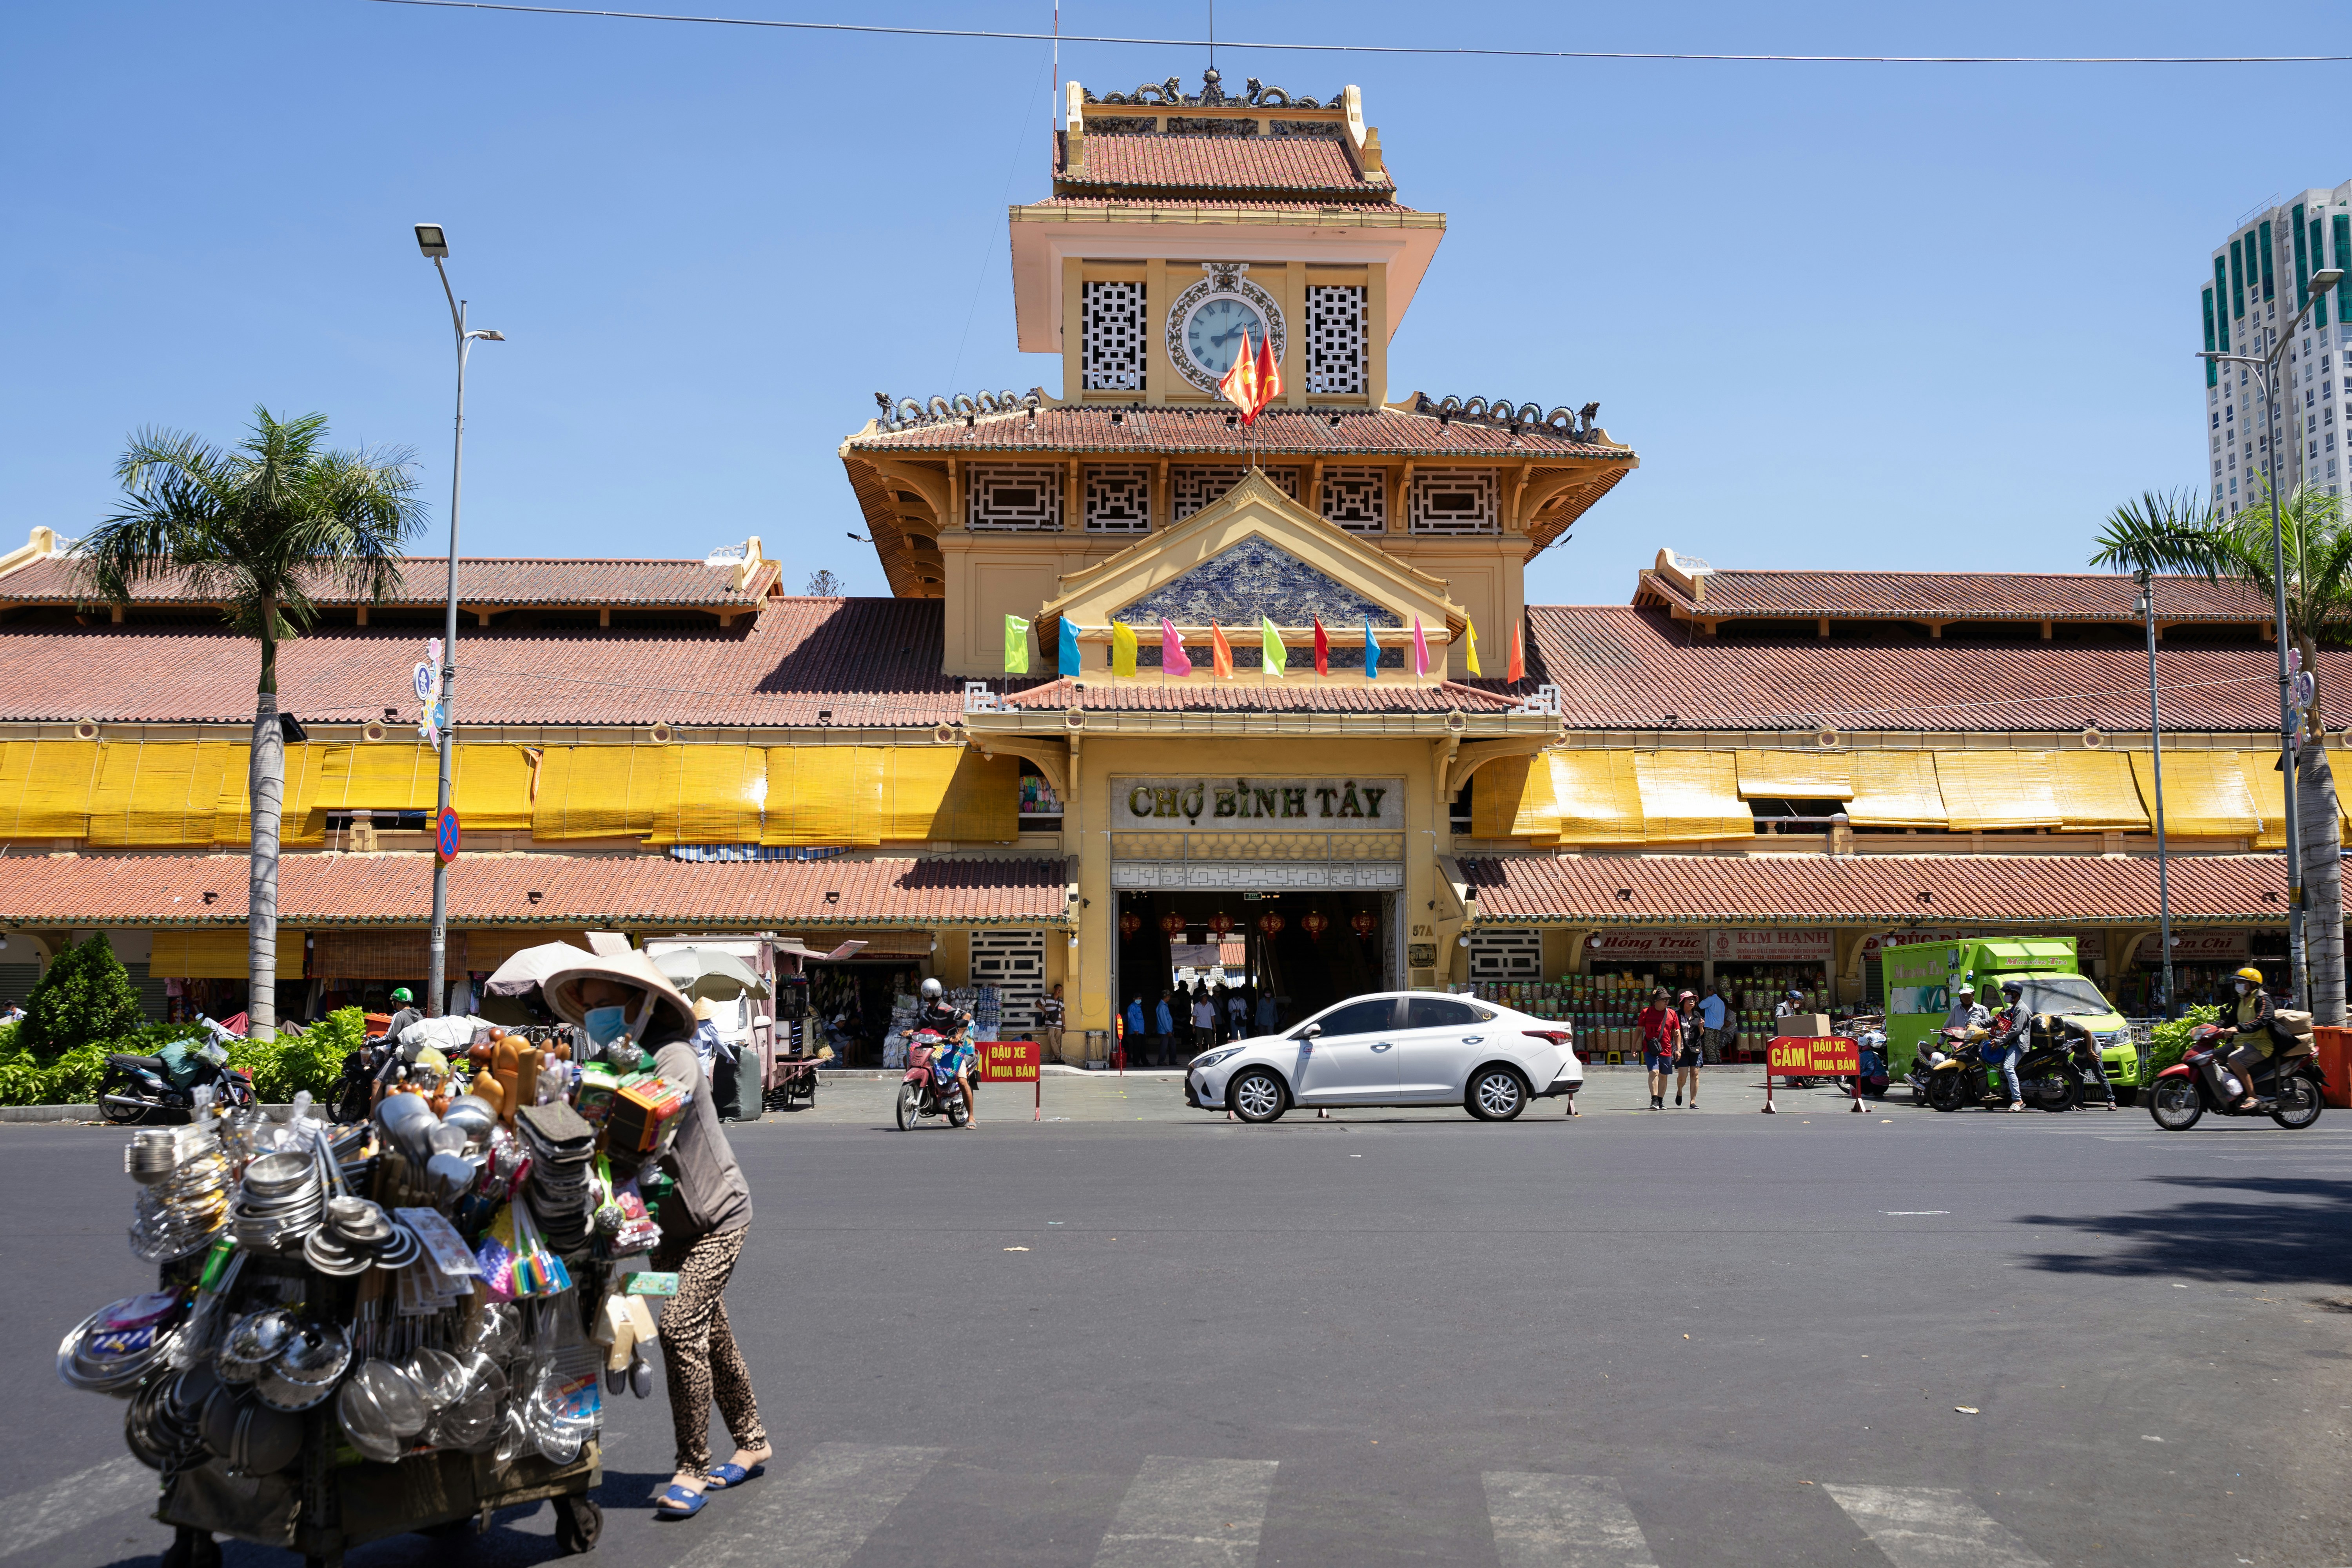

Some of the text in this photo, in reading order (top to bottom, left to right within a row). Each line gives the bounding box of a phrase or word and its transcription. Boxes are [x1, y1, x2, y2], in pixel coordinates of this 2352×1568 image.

[1129, 779, 1387, 826] CHỢ BÌNH TÂY
[1413, 925, 1433, 936] 57A
[1603, 935, 1700, 949] Hồng Trúc
[1737, 932, 1829, 946] KIM HẠNH
[2201, 938, 2233, 948] Chi
[991, 1045, 1026, 1061] ĐẬU XE
[1813, 1039, 1846, 1054] ĐẬU XE
[1771, 1042, 1805, 1067] CẤM
[992, 1063, 1036, 1077] MUA BÁN
[1814, 1057, 1856, 1071] MUA BÁN
